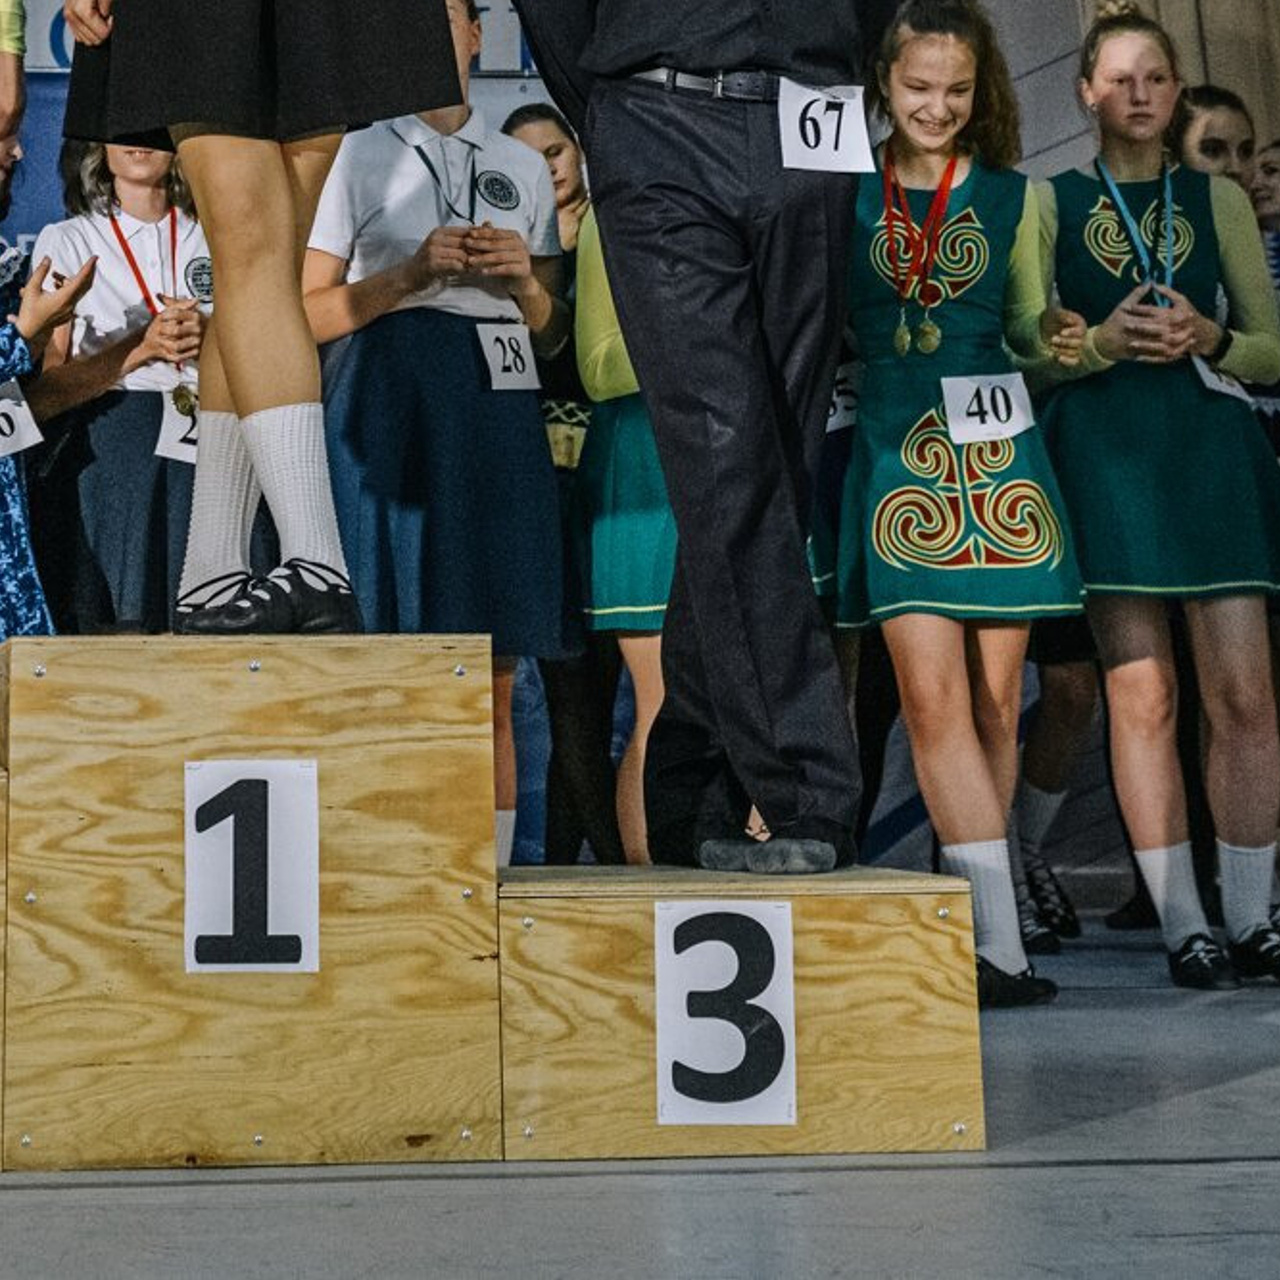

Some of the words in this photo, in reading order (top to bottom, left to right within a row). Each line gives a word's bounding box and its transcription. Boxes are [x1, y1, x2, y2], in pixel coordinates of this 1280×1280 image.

[798, 97, 846, 152] 67
[492, 334, 527, 376] 28
[965, 384, 1013, 425] 40
[194, 778, 303, 965] 1
[671, 911, 787, 1104] 3
